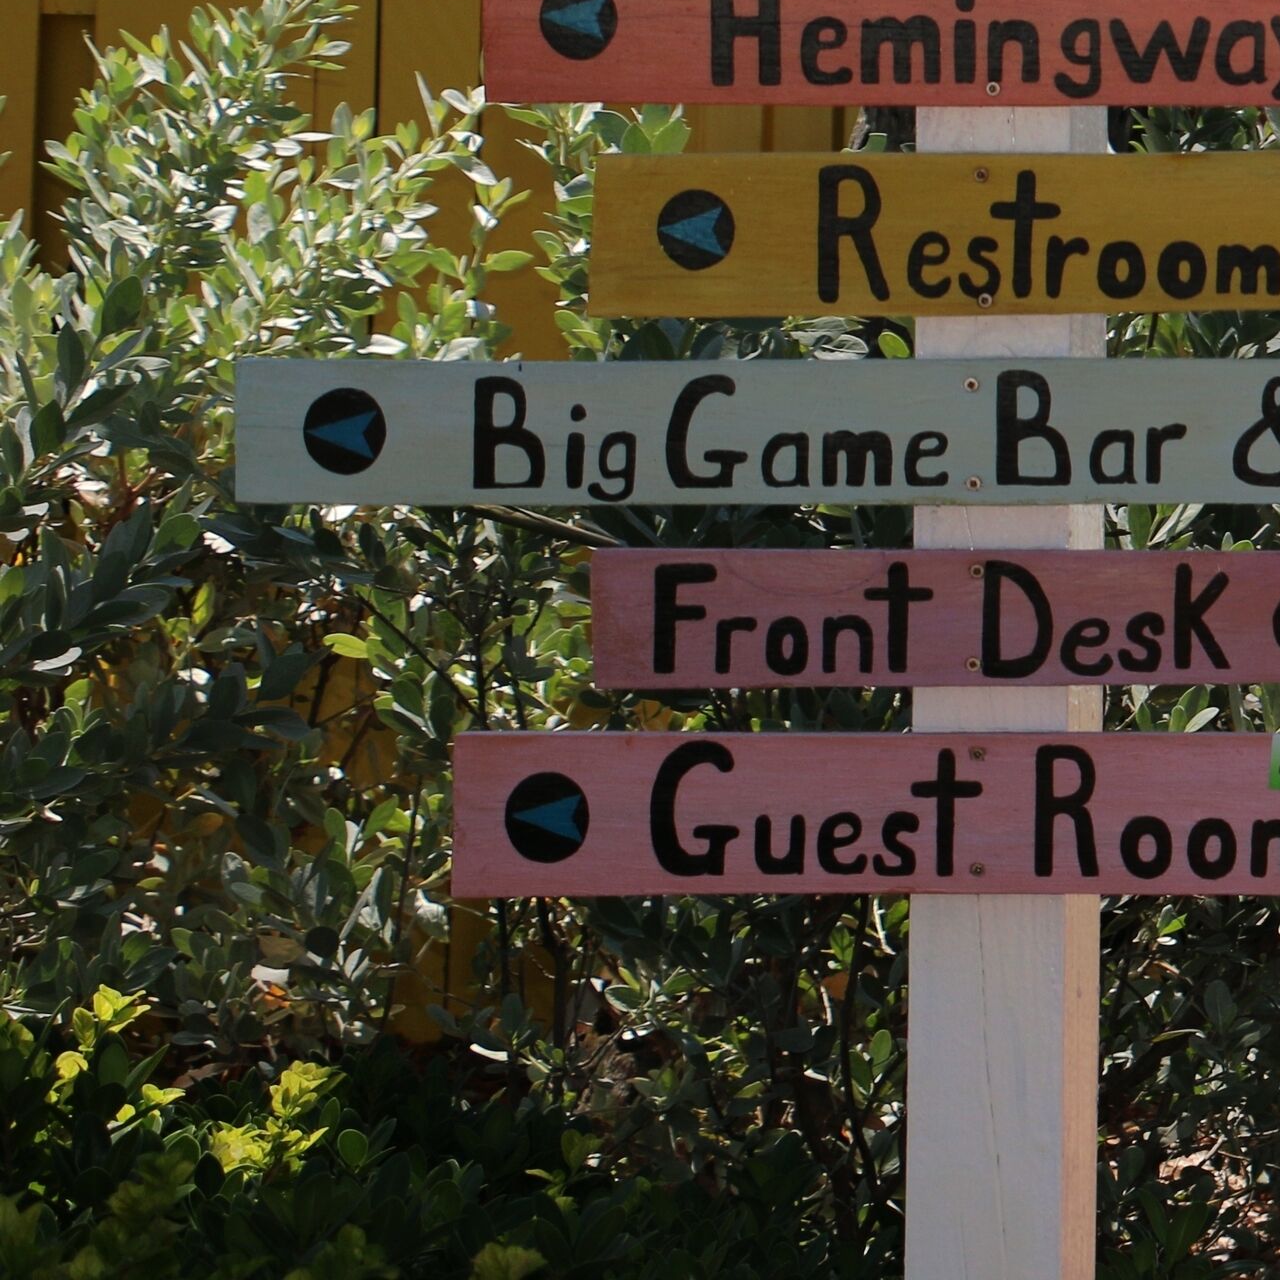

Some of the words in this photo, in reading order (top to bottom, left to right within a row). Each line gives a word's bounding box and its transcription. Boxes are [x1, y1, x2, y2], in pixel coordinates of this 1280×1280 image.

[473, 376, 636, 502] Big
[666, 376, 948, 489] Game
[996, 370, 1187, 486] Bar
[653, 561, 933, 676] Front
[650, 740, 983, 878] Guest
